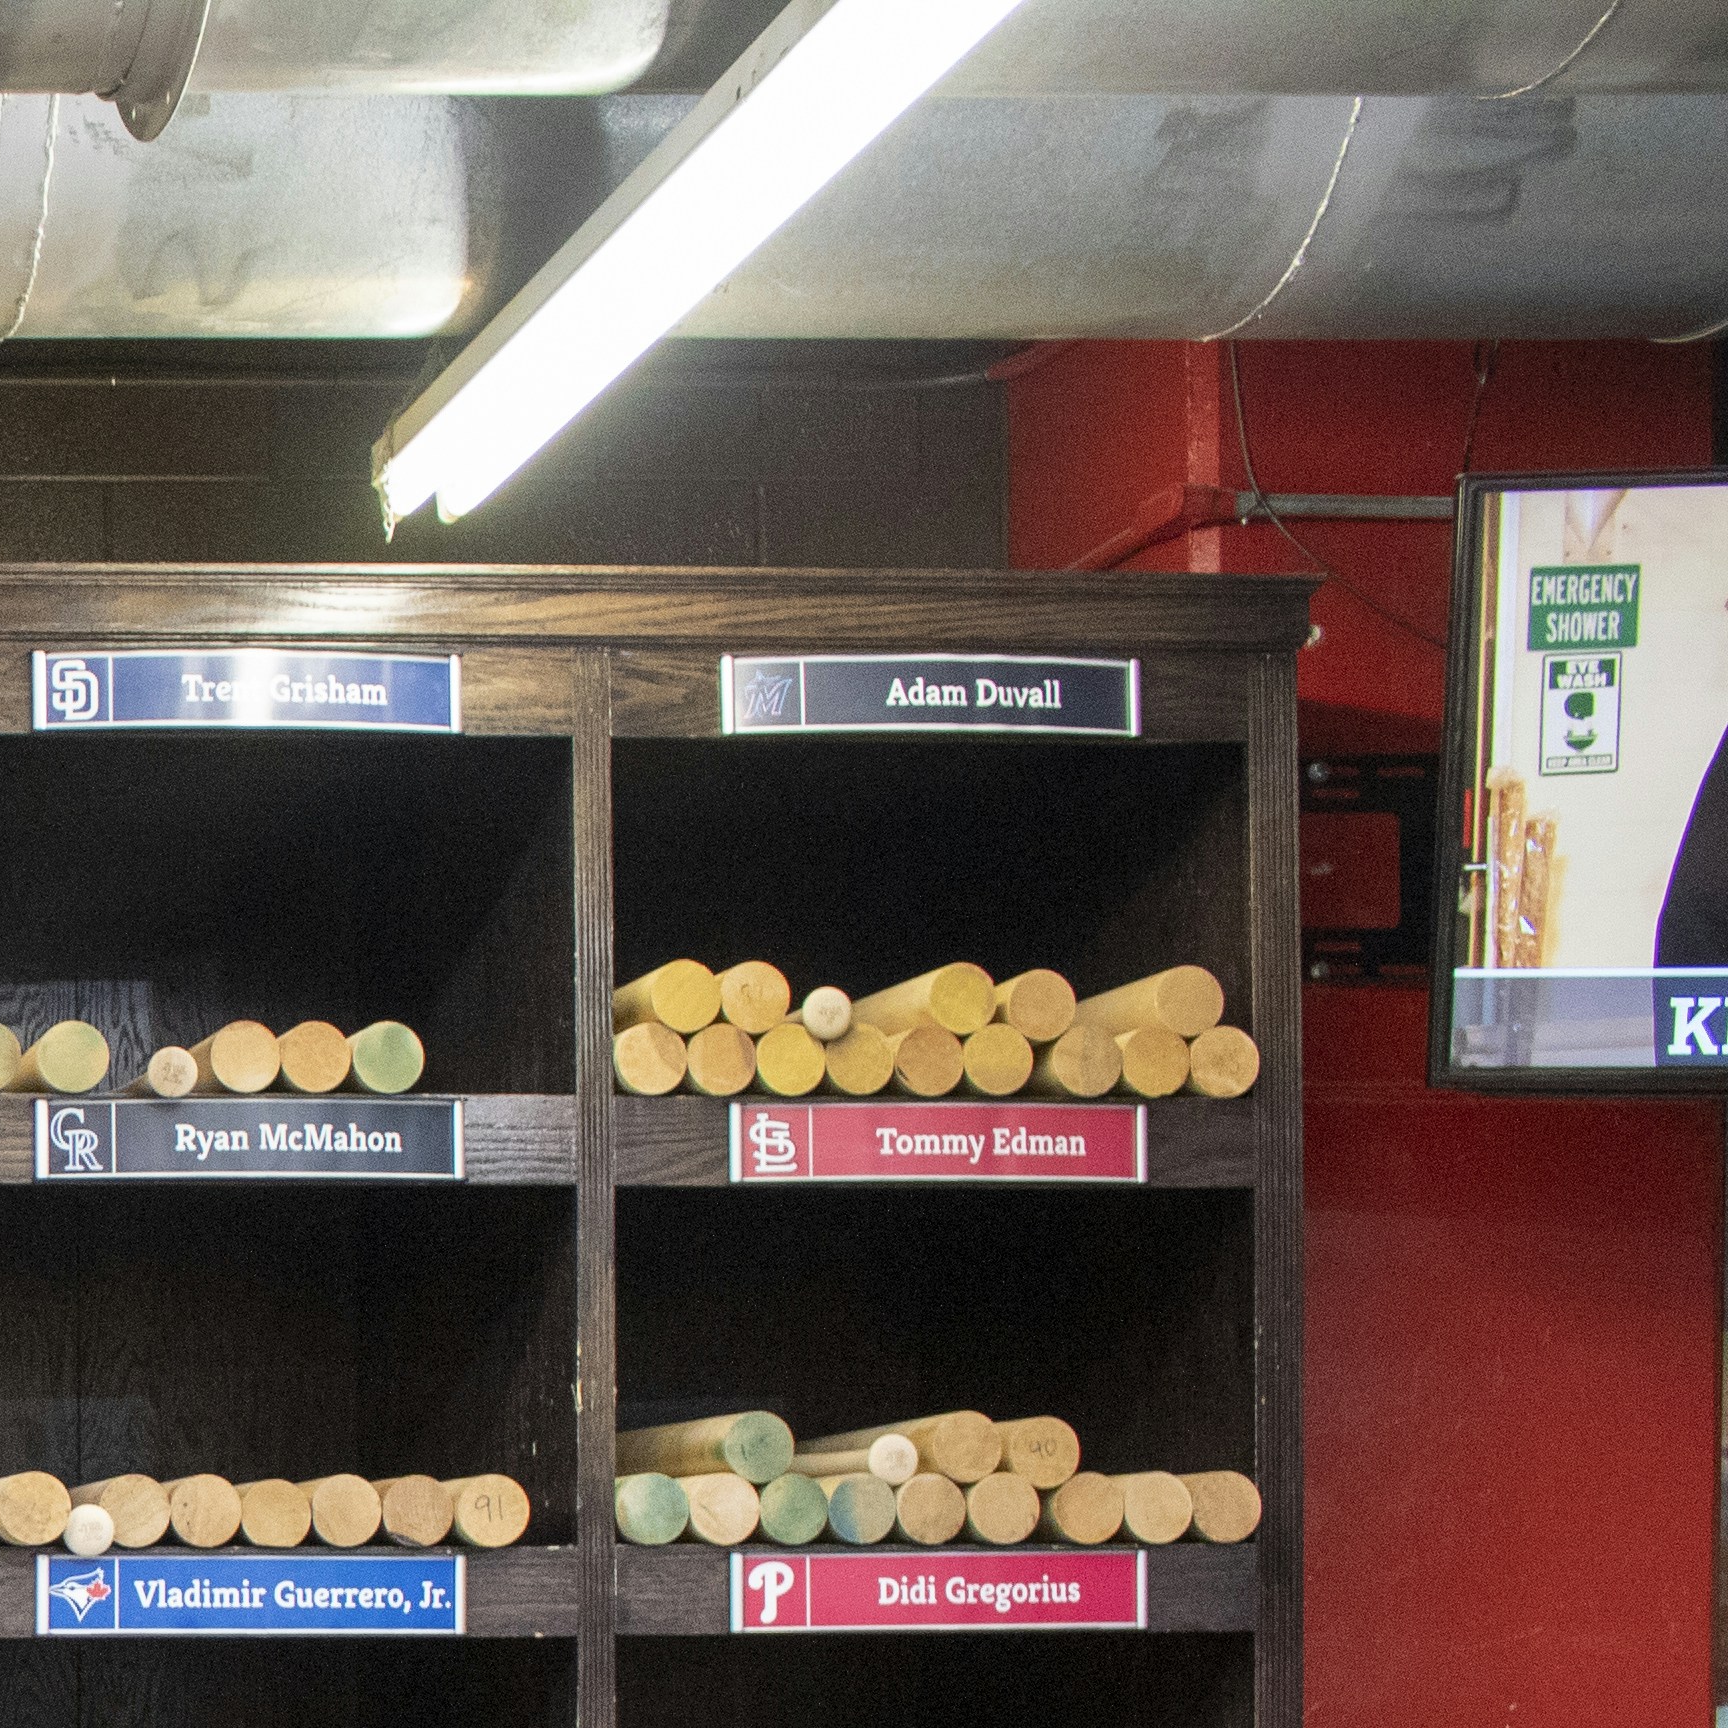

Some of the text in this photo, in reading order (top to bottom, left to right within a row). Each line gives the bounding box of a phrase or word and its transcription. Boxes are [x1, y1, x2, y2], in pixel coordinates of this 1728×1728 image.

[1531, 572, 1639, 606] EMERGENCY
[1545, 611, 1623, 645] SHOWER
[181, 674, 388, 705] Tre Grisham
[886, 677, 1061, 708] Adam Duvall
[176, 1123, 402, 1160] Ryan McMahon
[876, 1127, 1085, 1164] Tommy Edman
[134, 1579, 451, 1613] Vladimir Guerrero, Jr.
[749, 1562, 793, 1623] P
[878, 1575, 1080, 1613] Didi Gregorius
